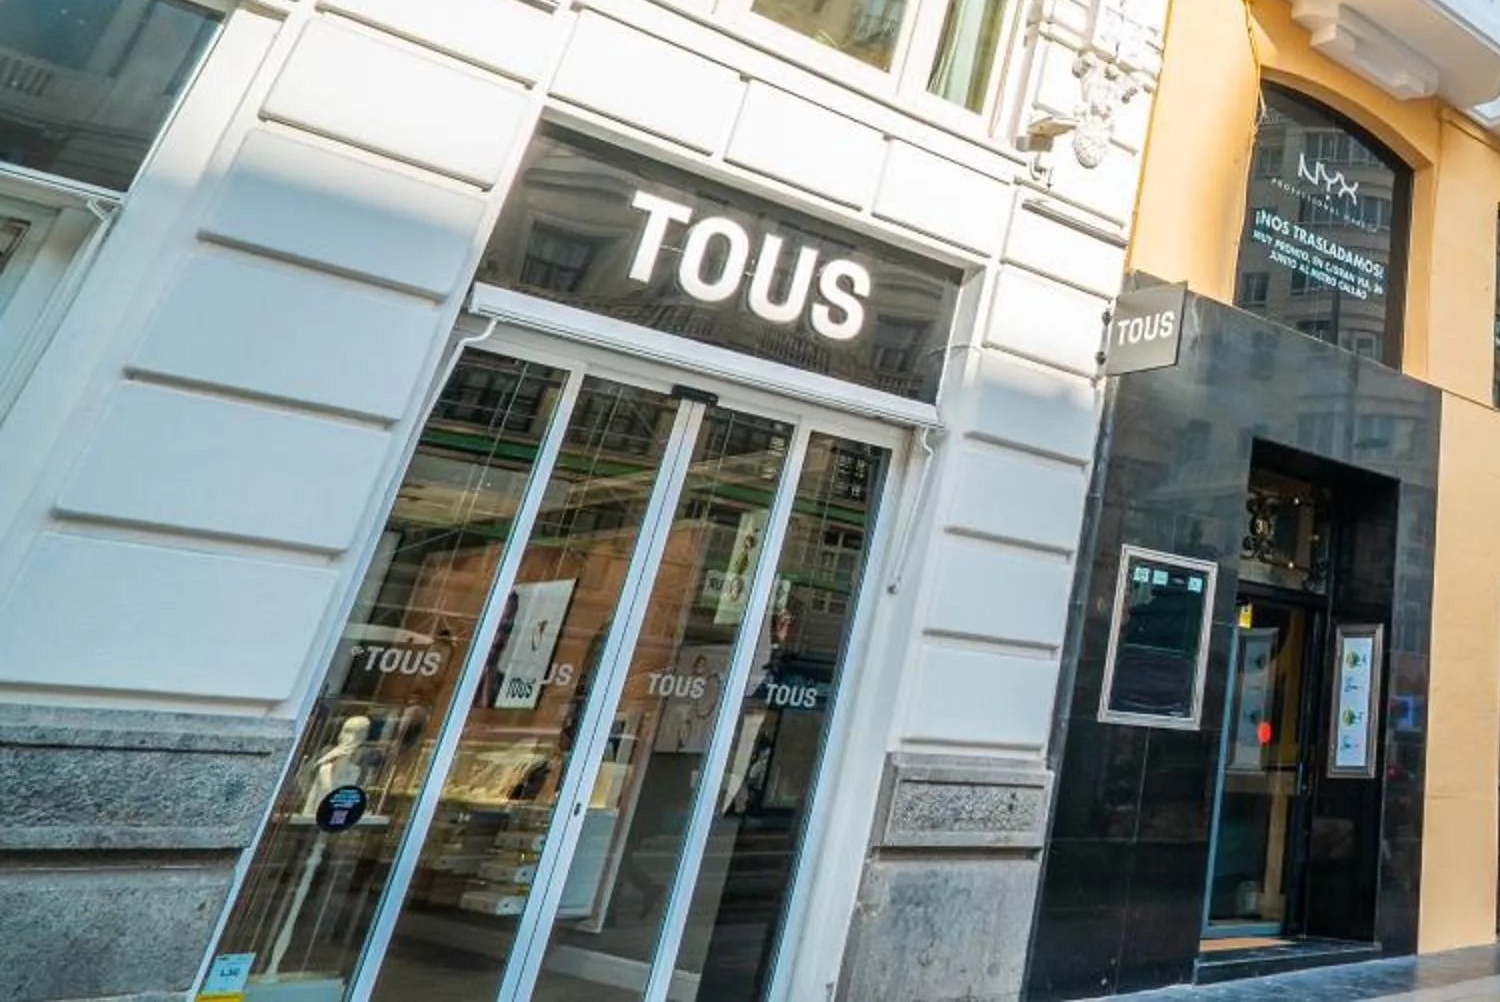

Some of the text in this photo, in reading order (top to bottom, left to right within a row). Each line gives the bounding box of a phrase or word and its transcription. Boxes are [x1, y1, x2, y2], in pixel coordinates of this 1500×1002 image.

[1298, 153, 1359, 206] NYX
[628, 189, 871, 340] TOUS
[1292, 225, 1385, 279] TRASLADAMOS!
[1117, 310, 1175, 346] TOUS
[363, 646, 442, 677] TOUS
[648, 672, 707, 699] TOUS
[765, 683, 818, 708] TOUS
